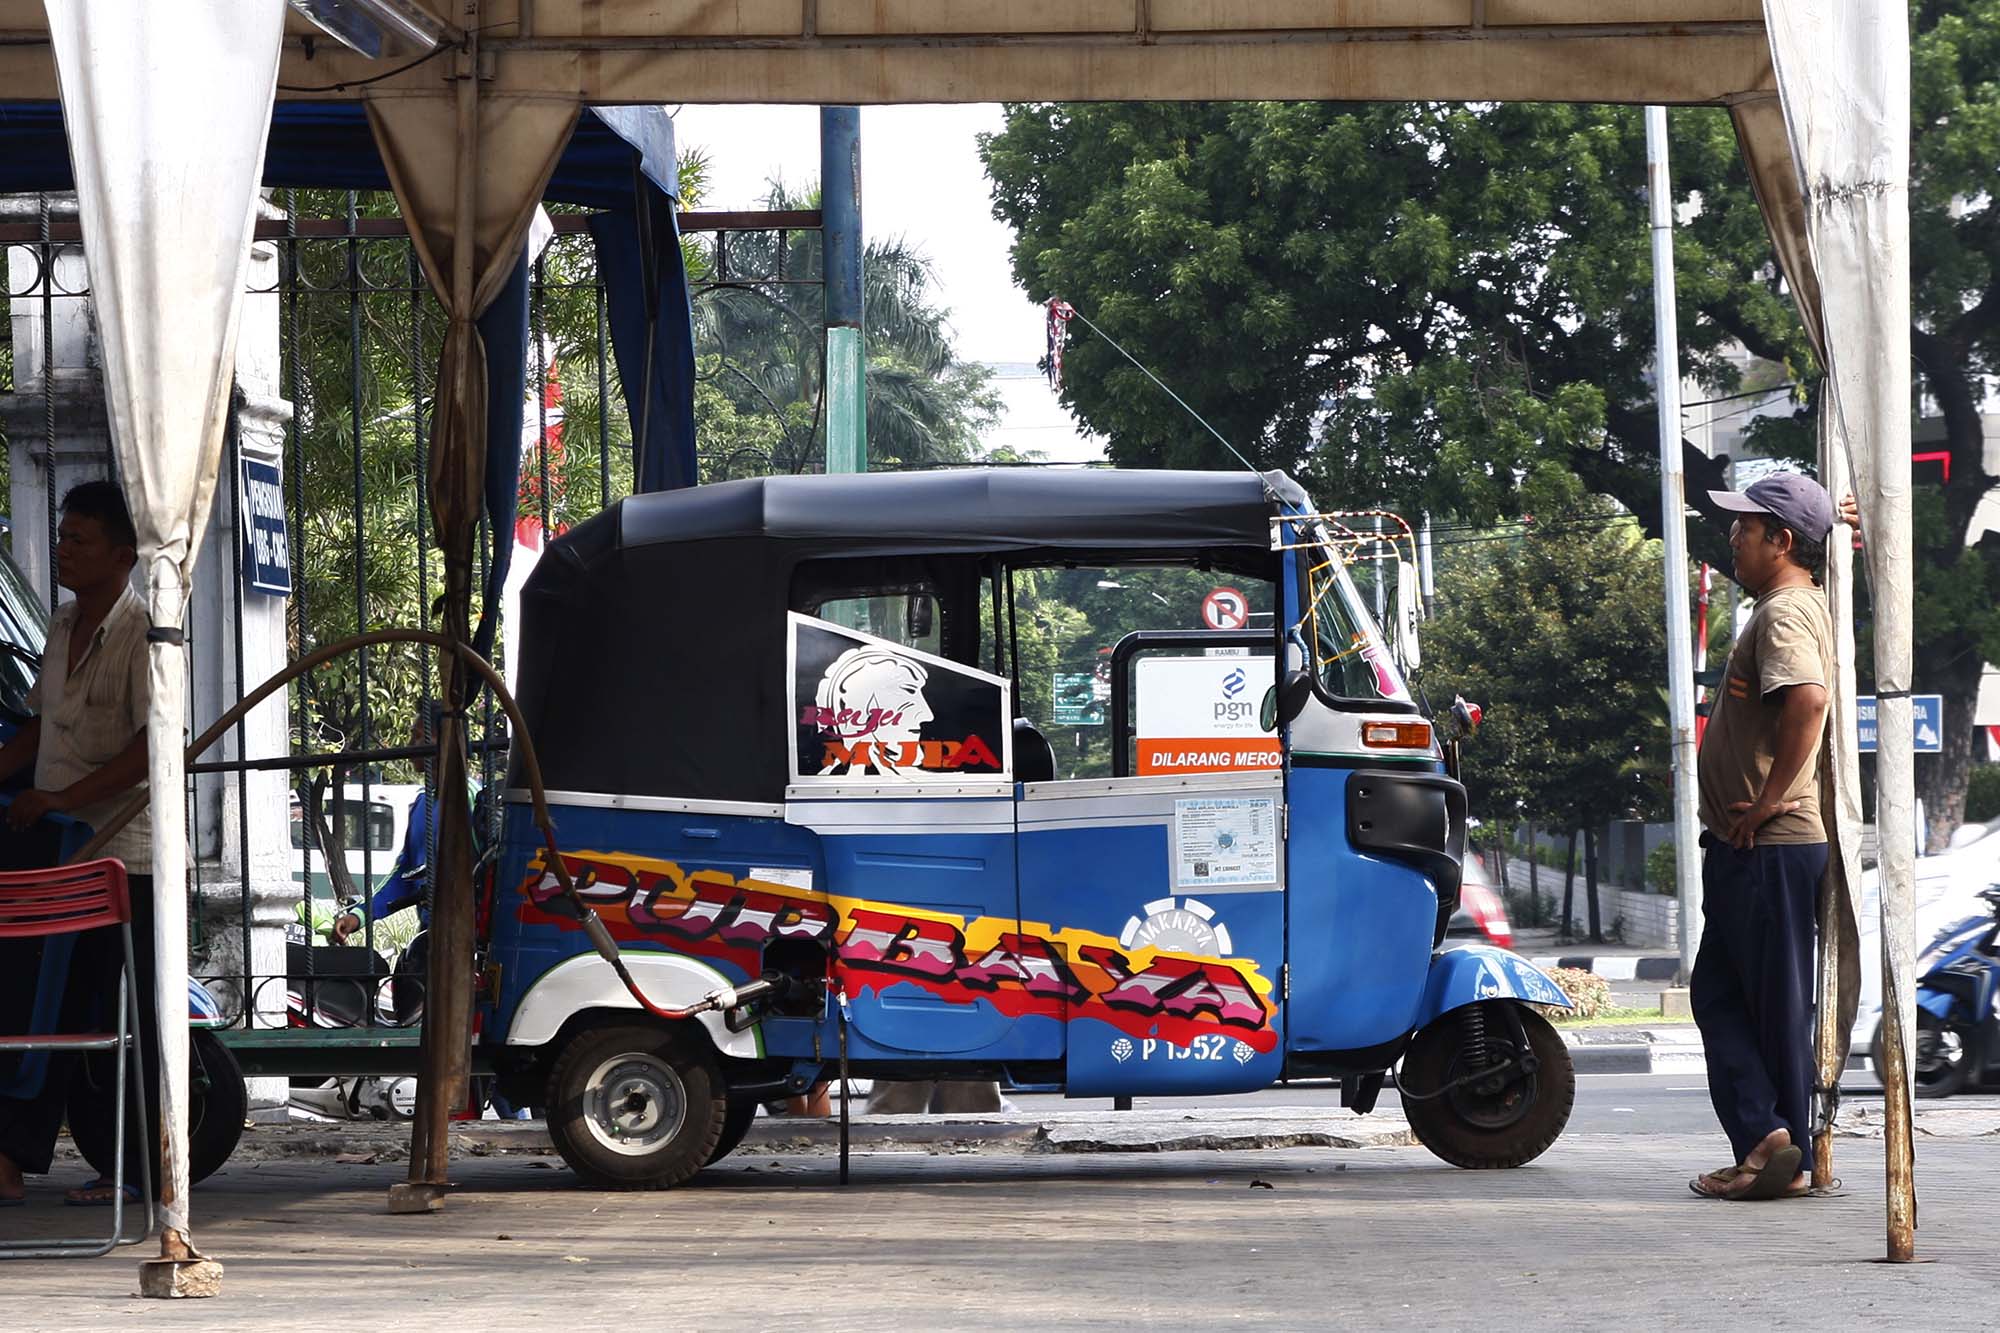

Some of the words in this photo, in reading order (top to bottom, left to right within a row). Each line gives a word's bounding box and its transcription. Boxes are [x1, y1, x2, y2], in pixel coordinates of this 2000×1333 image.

[1214, 702, 1253, 721] pgn
[1151, 752, 1231, 767] DILARANG
[1138, 910, 1214, 947] JAKARTA
[1142, 1038, 1157, 1061] P
